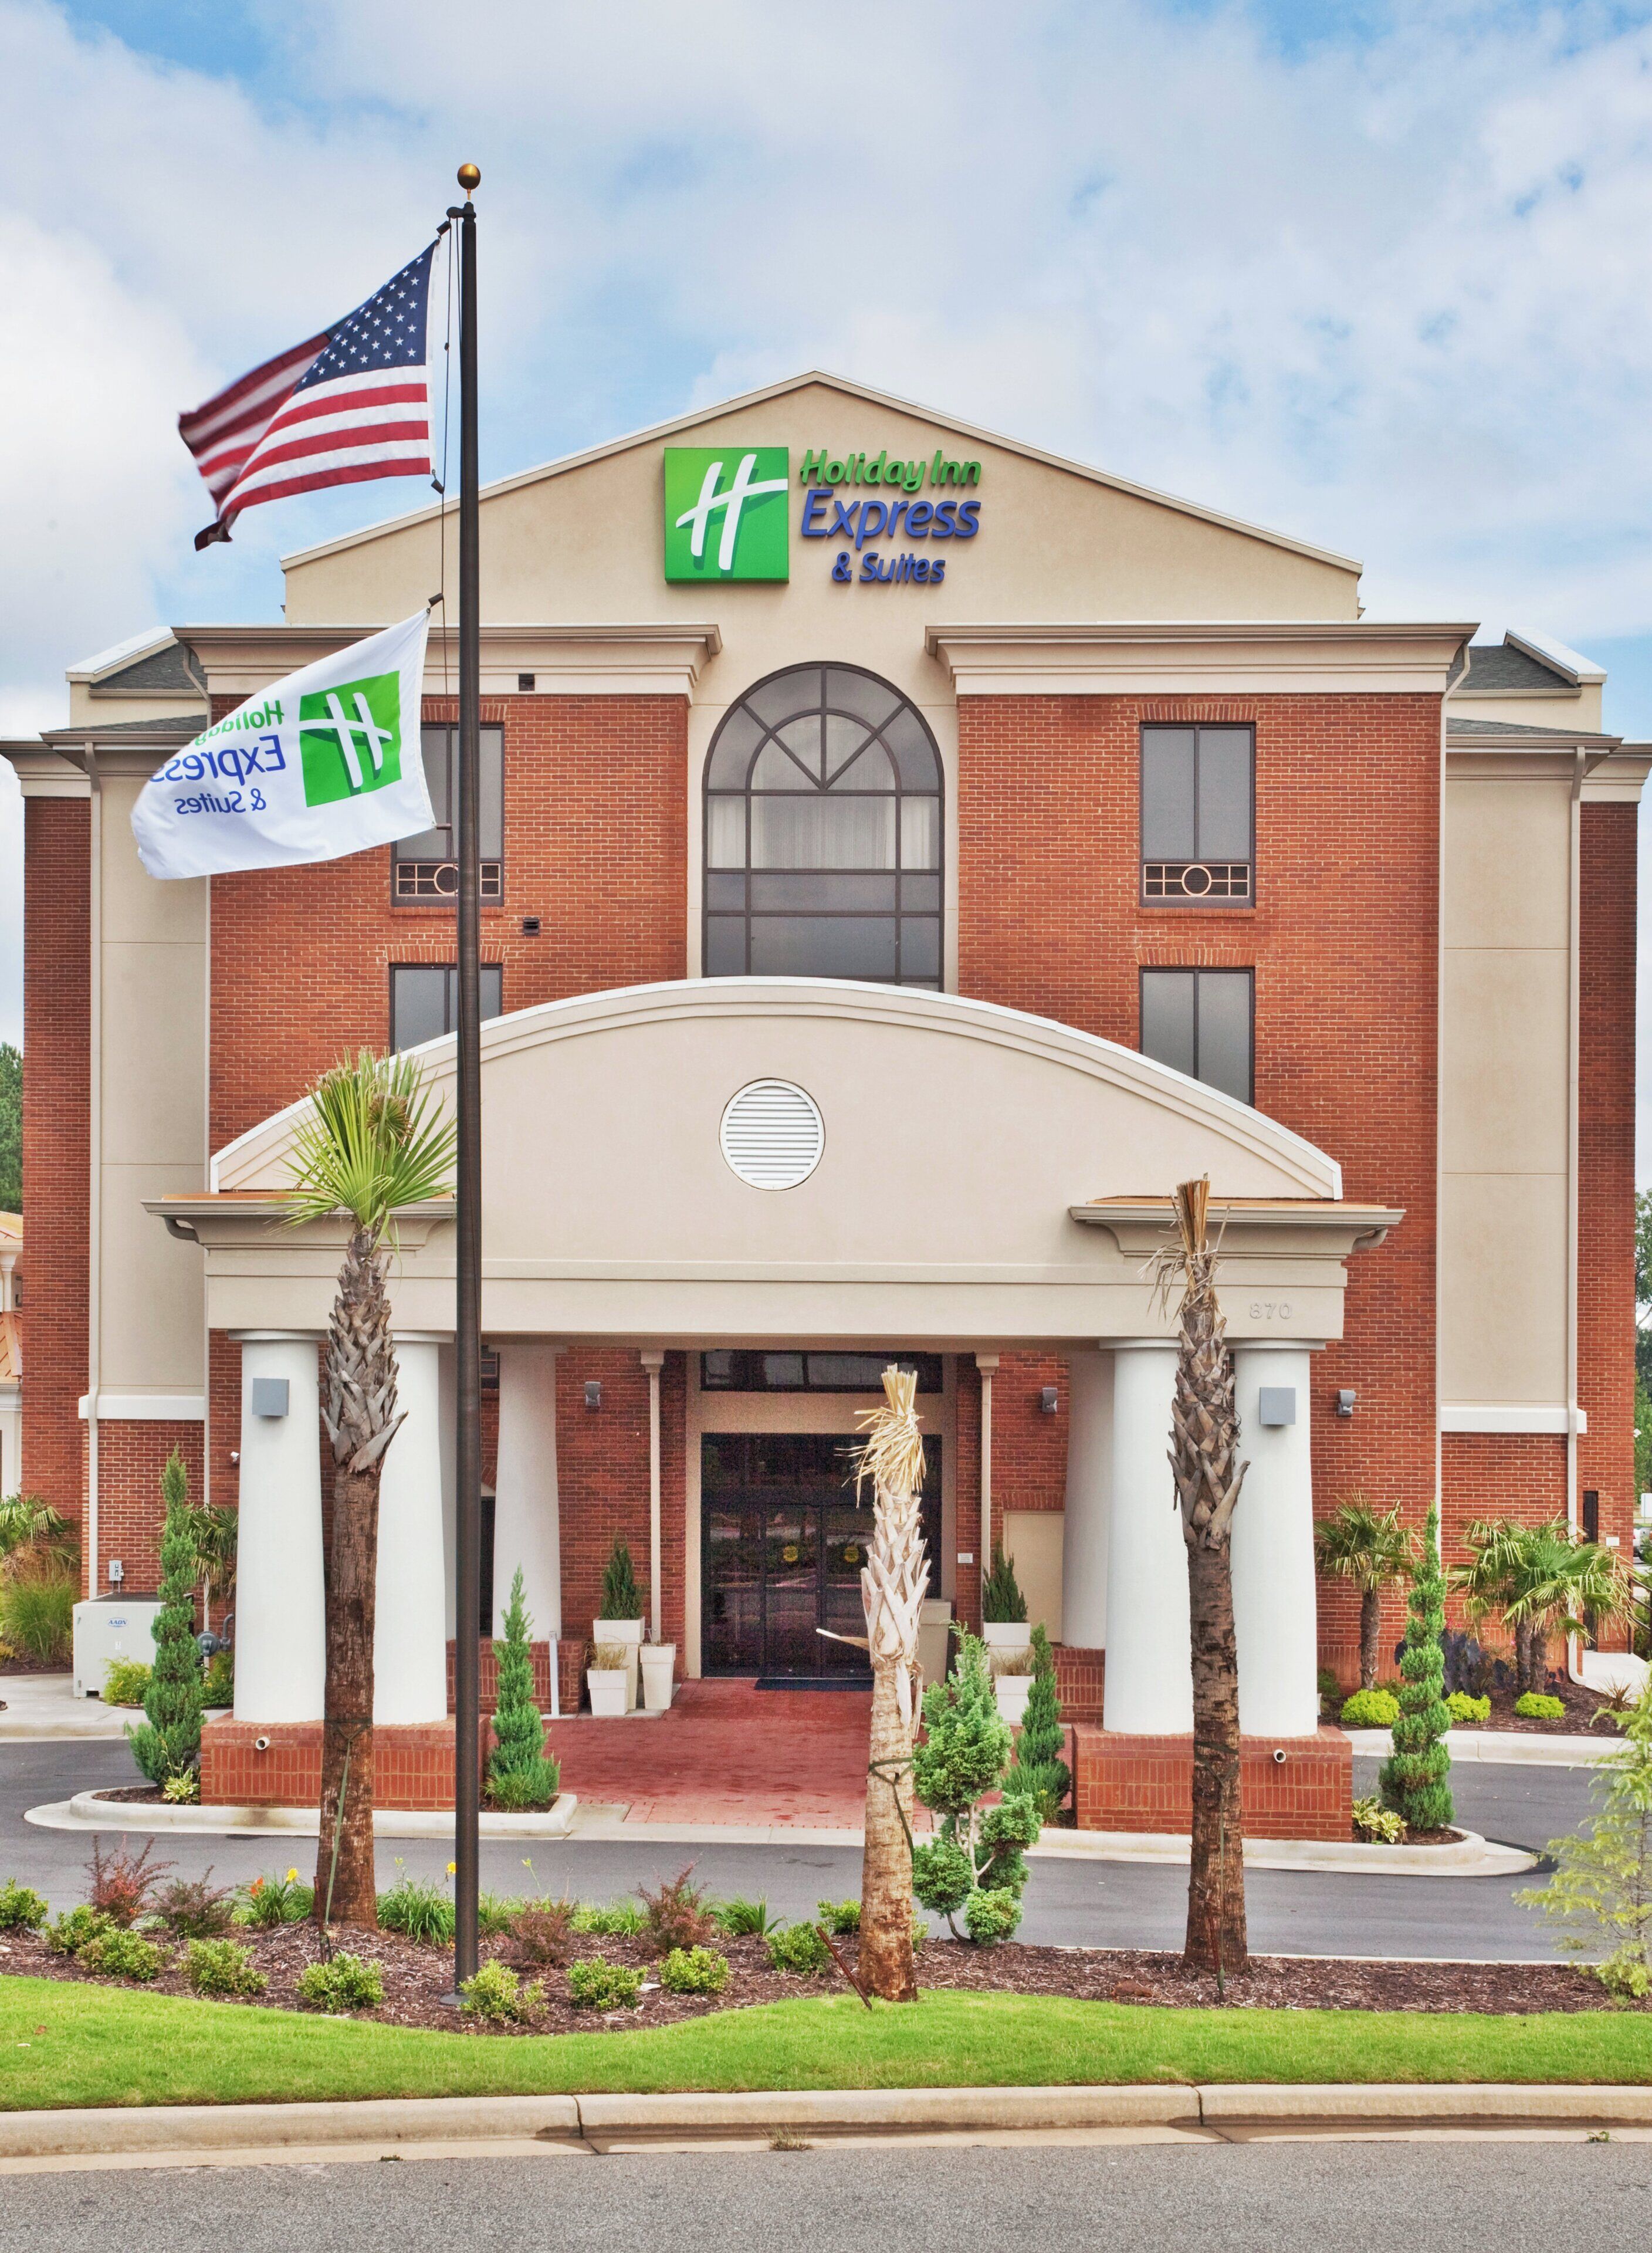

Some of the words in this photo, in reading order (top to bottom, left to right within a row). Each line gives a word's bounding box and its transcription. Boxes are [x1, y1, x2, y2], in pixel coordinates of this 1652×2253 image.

[800, 449, 926, 493] Holiday
[930, 450, 982, 486] Inn
[801, 489, 981, 551] Express
[832, 552, 852, 583] &
[859, 552, 946, 583] Suites
[1250, 1303, 1292, 1320] 870
